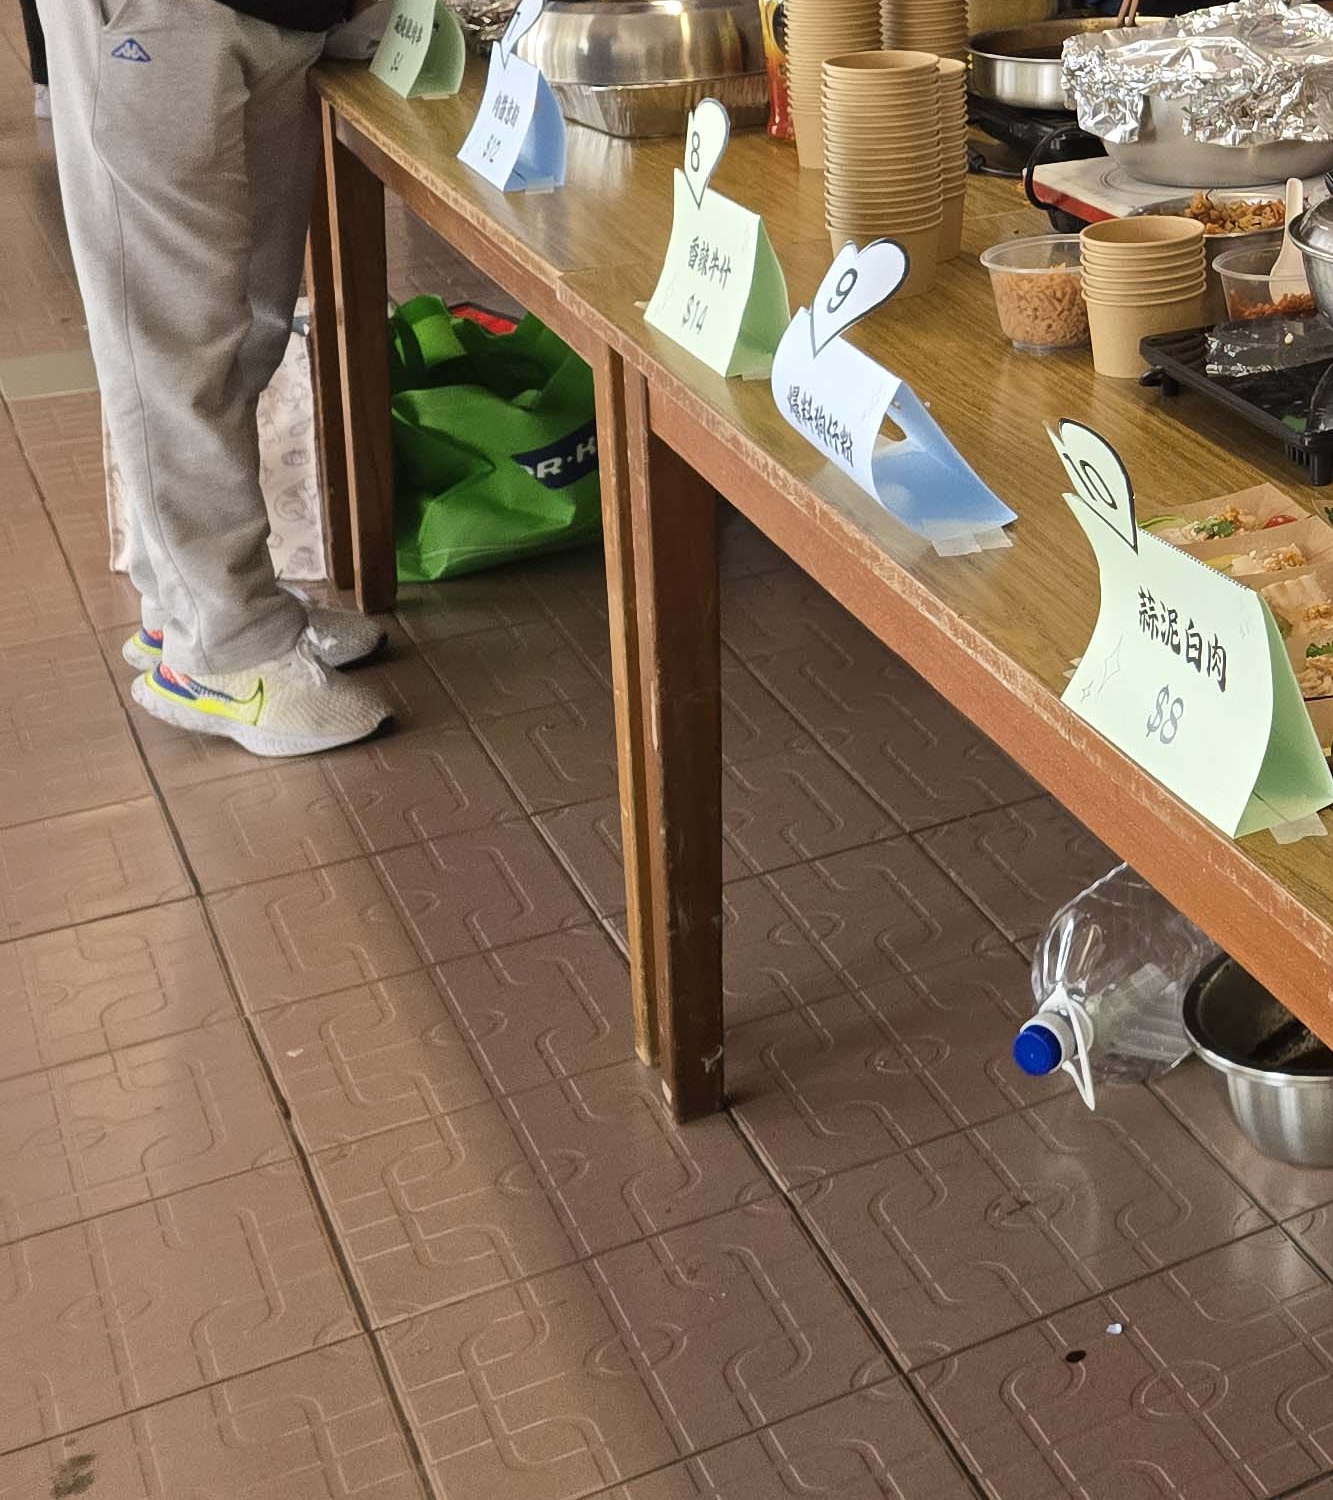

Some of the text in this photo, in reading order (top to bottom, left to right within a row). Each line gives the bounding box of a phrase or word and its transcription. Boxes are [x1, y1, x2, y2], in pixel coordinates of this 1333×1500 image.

[690, 130, 701, 173] 8
[681, 293, 710, 335] $14
[826, 267, 858, 314] 9
[1060, 451, 1118, 510] 10
[1136, 584, 1230, 694] 蒜泥白肉
[1145, 683, 1186, 746] $8
